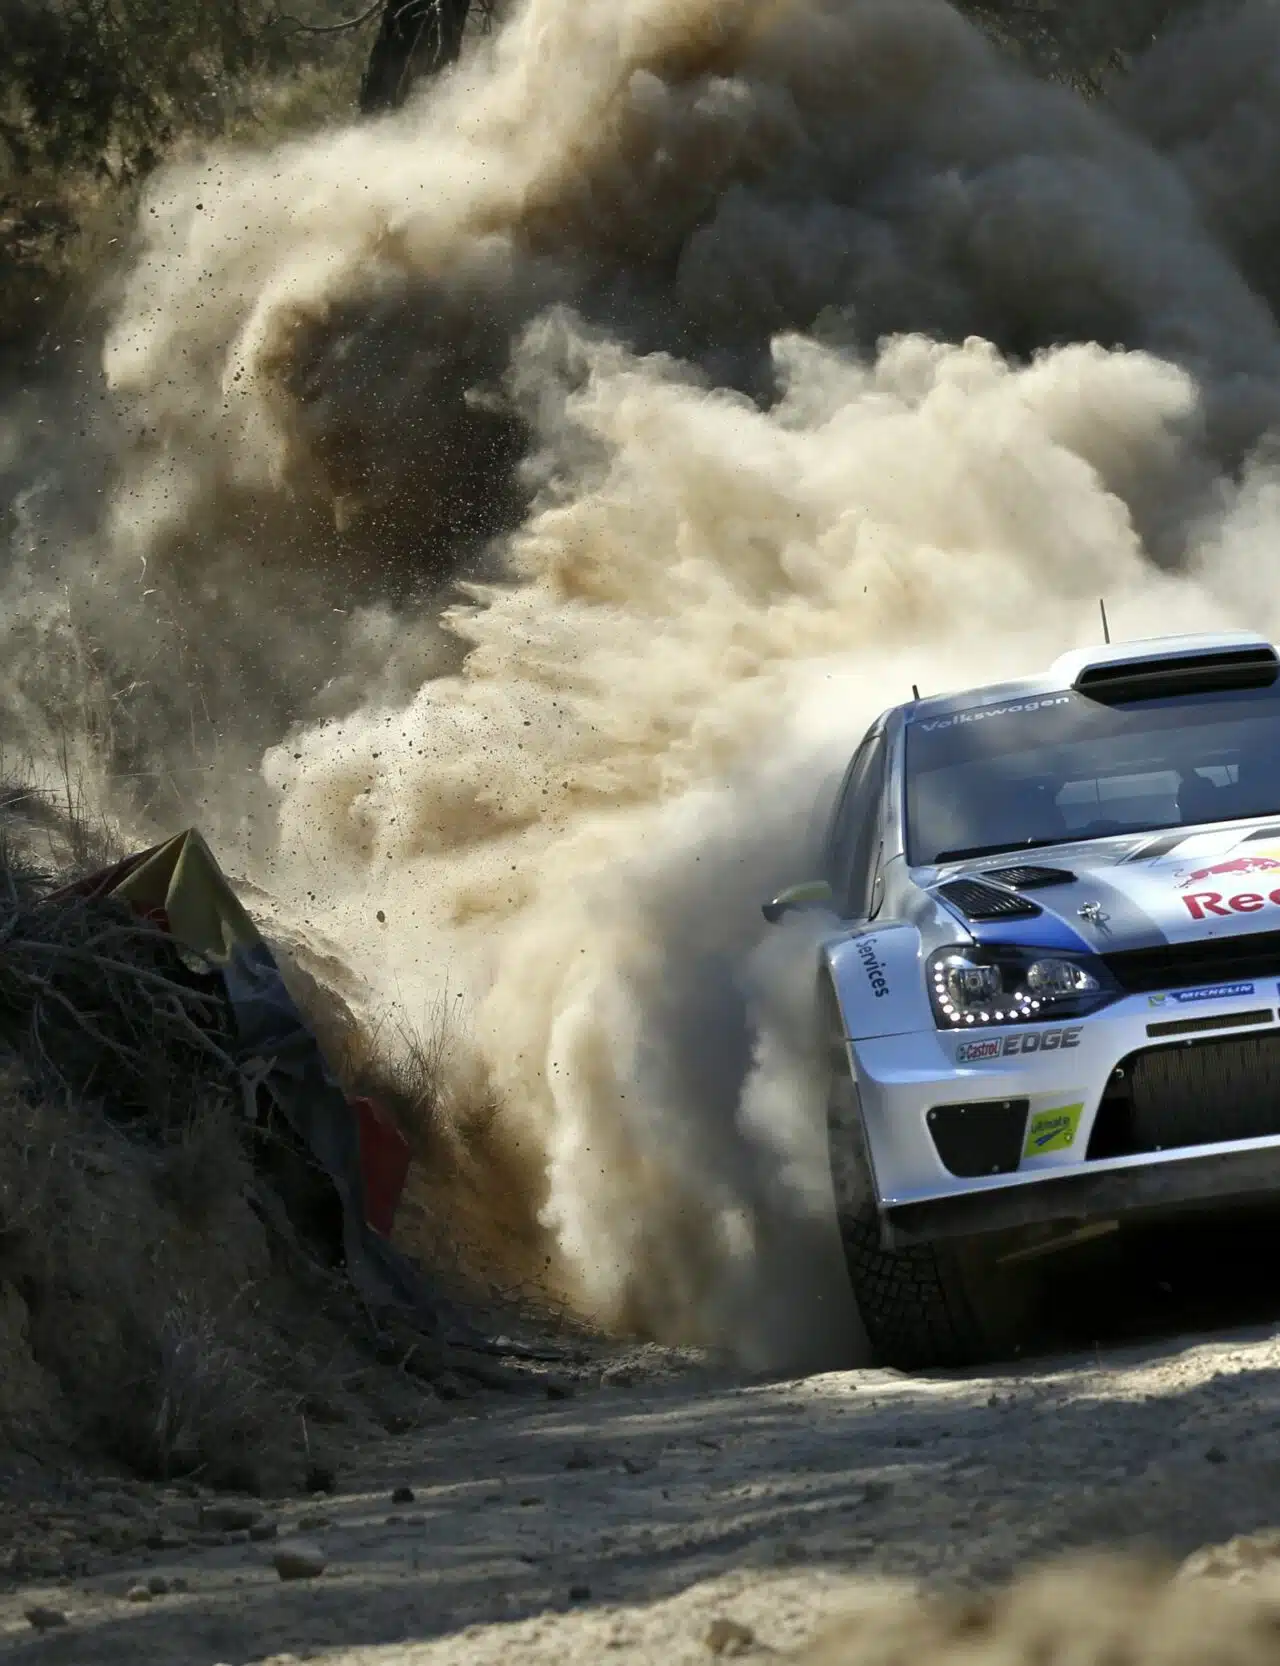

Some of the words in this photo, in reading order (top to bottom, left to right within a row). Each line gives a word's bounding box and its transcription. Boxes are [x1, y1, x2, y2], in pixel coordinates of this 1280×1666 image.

[921, 697, 1070, 732] Volkswagen
[856, 938, 890, 998] Services
[1180, 984, 1252, 999] MICHELIN
[967, 1041, 998, 1060] Castrol
[1002, 1026, 1083, 1056] EDGE
